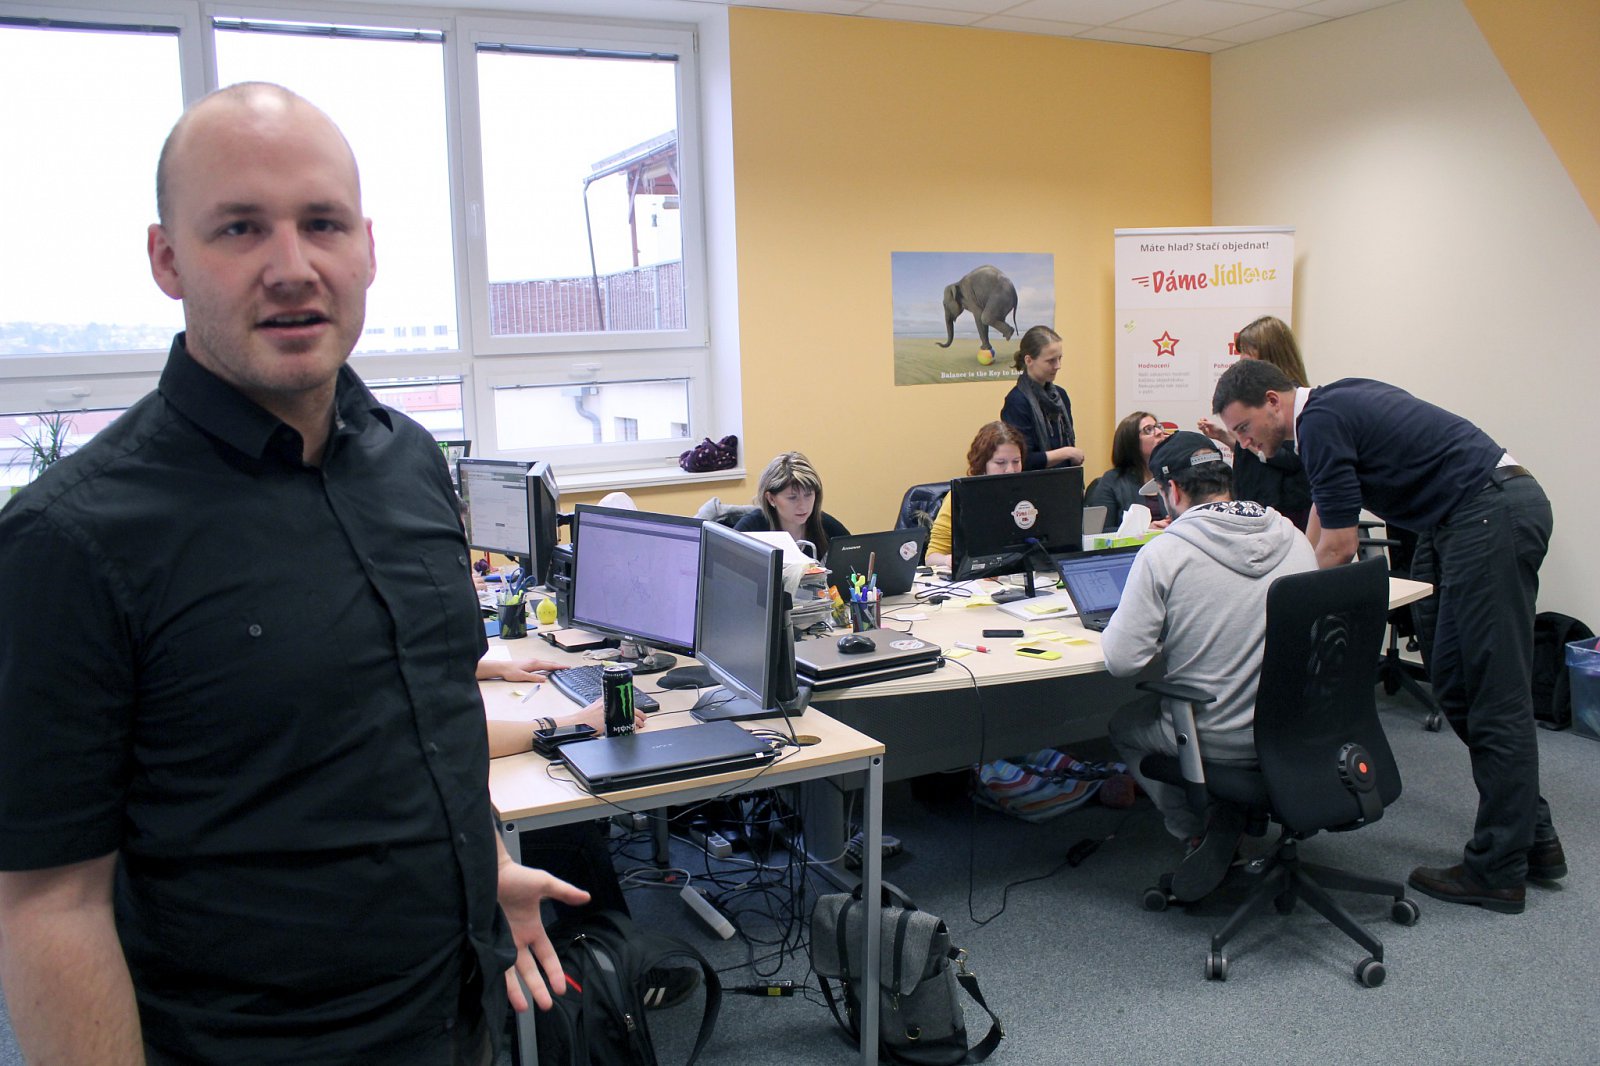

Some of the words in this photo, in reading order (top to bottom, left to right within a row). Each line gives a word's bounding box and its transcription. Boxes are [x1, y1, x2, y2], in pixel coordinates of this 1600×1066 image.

[1140, 242, 1165, 252] Máte
[1168, 242, 1193, 251] hlad?
[1196, 242, 1220, 251] Stačí
[1222, 241, 1269, 253] objednat!
[941, 371, 966, 379] Balance
[988, 369, 1000, 378] Key
